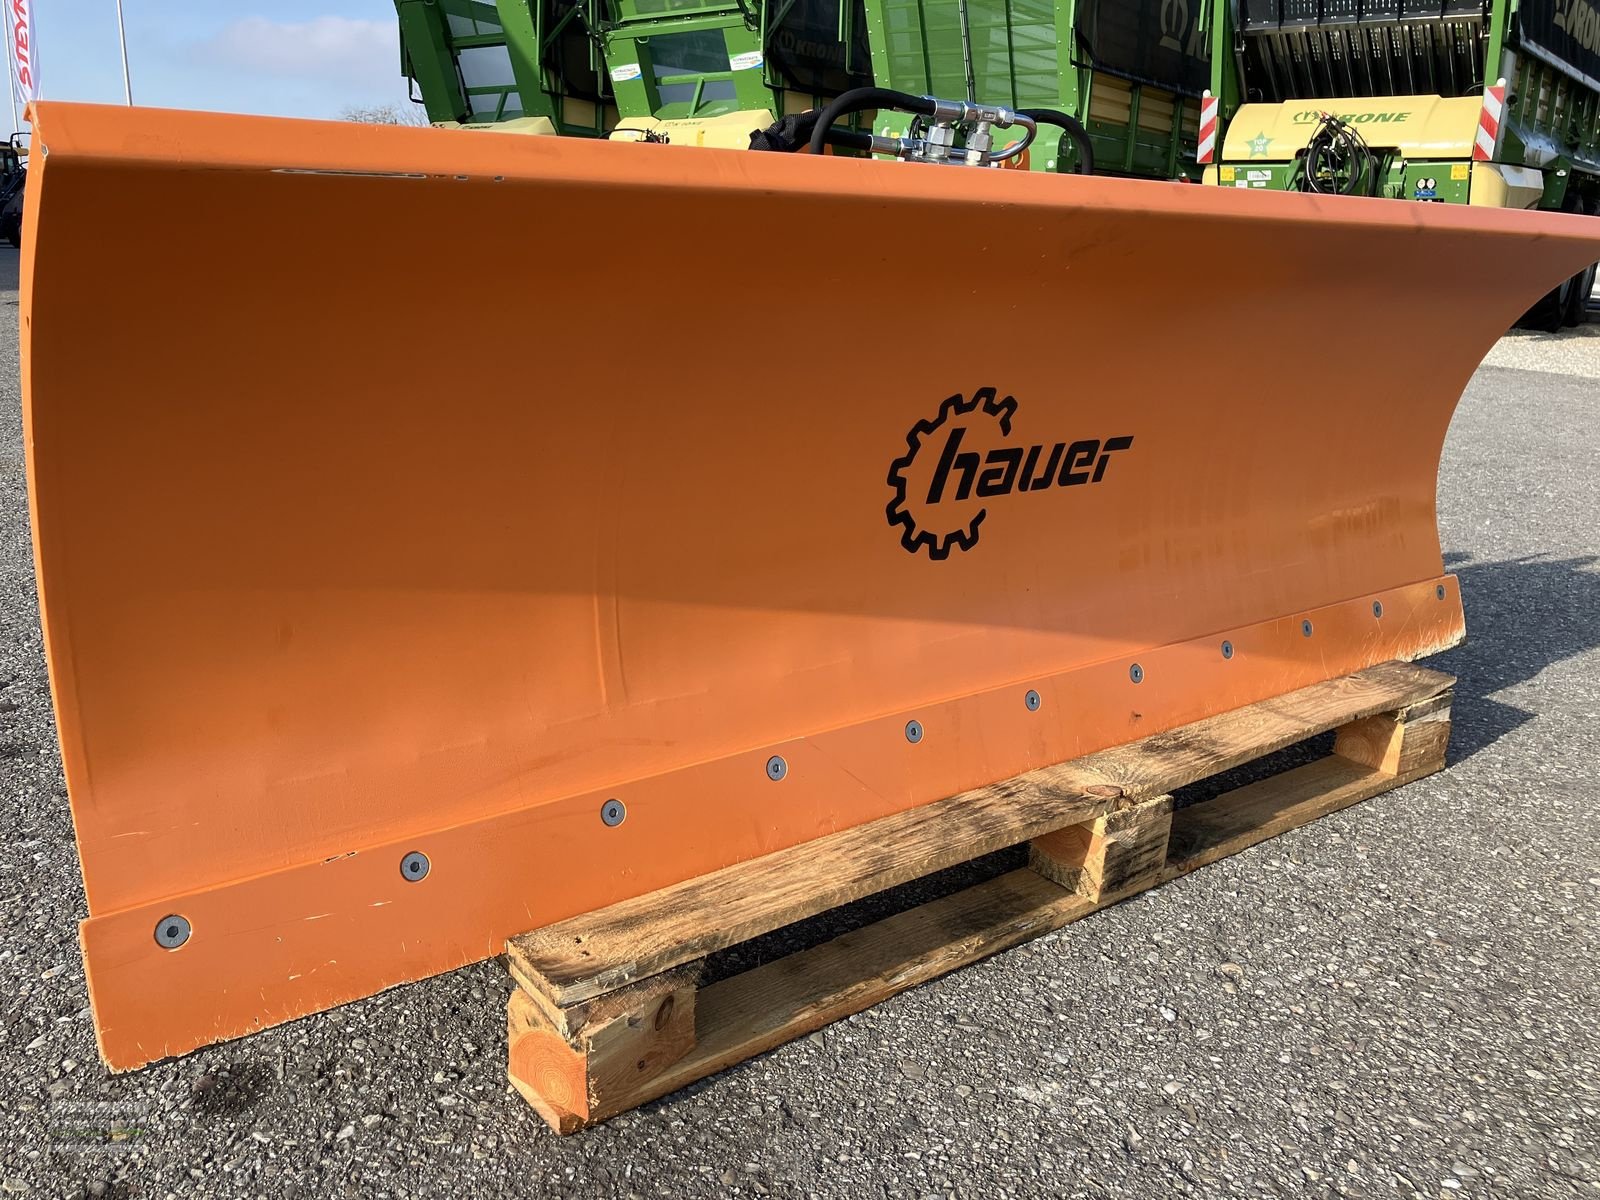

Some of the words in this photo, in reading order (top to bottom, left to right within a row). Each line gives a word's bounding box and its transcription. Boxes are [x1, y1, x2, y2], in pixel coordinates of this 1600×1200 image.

[795, 39, 843, 63] KRON
[1330, 111, 1412, 123] RONE
[1253, 138, 1267, 146] TOP
[926, 427, 1134, 504] hauer
